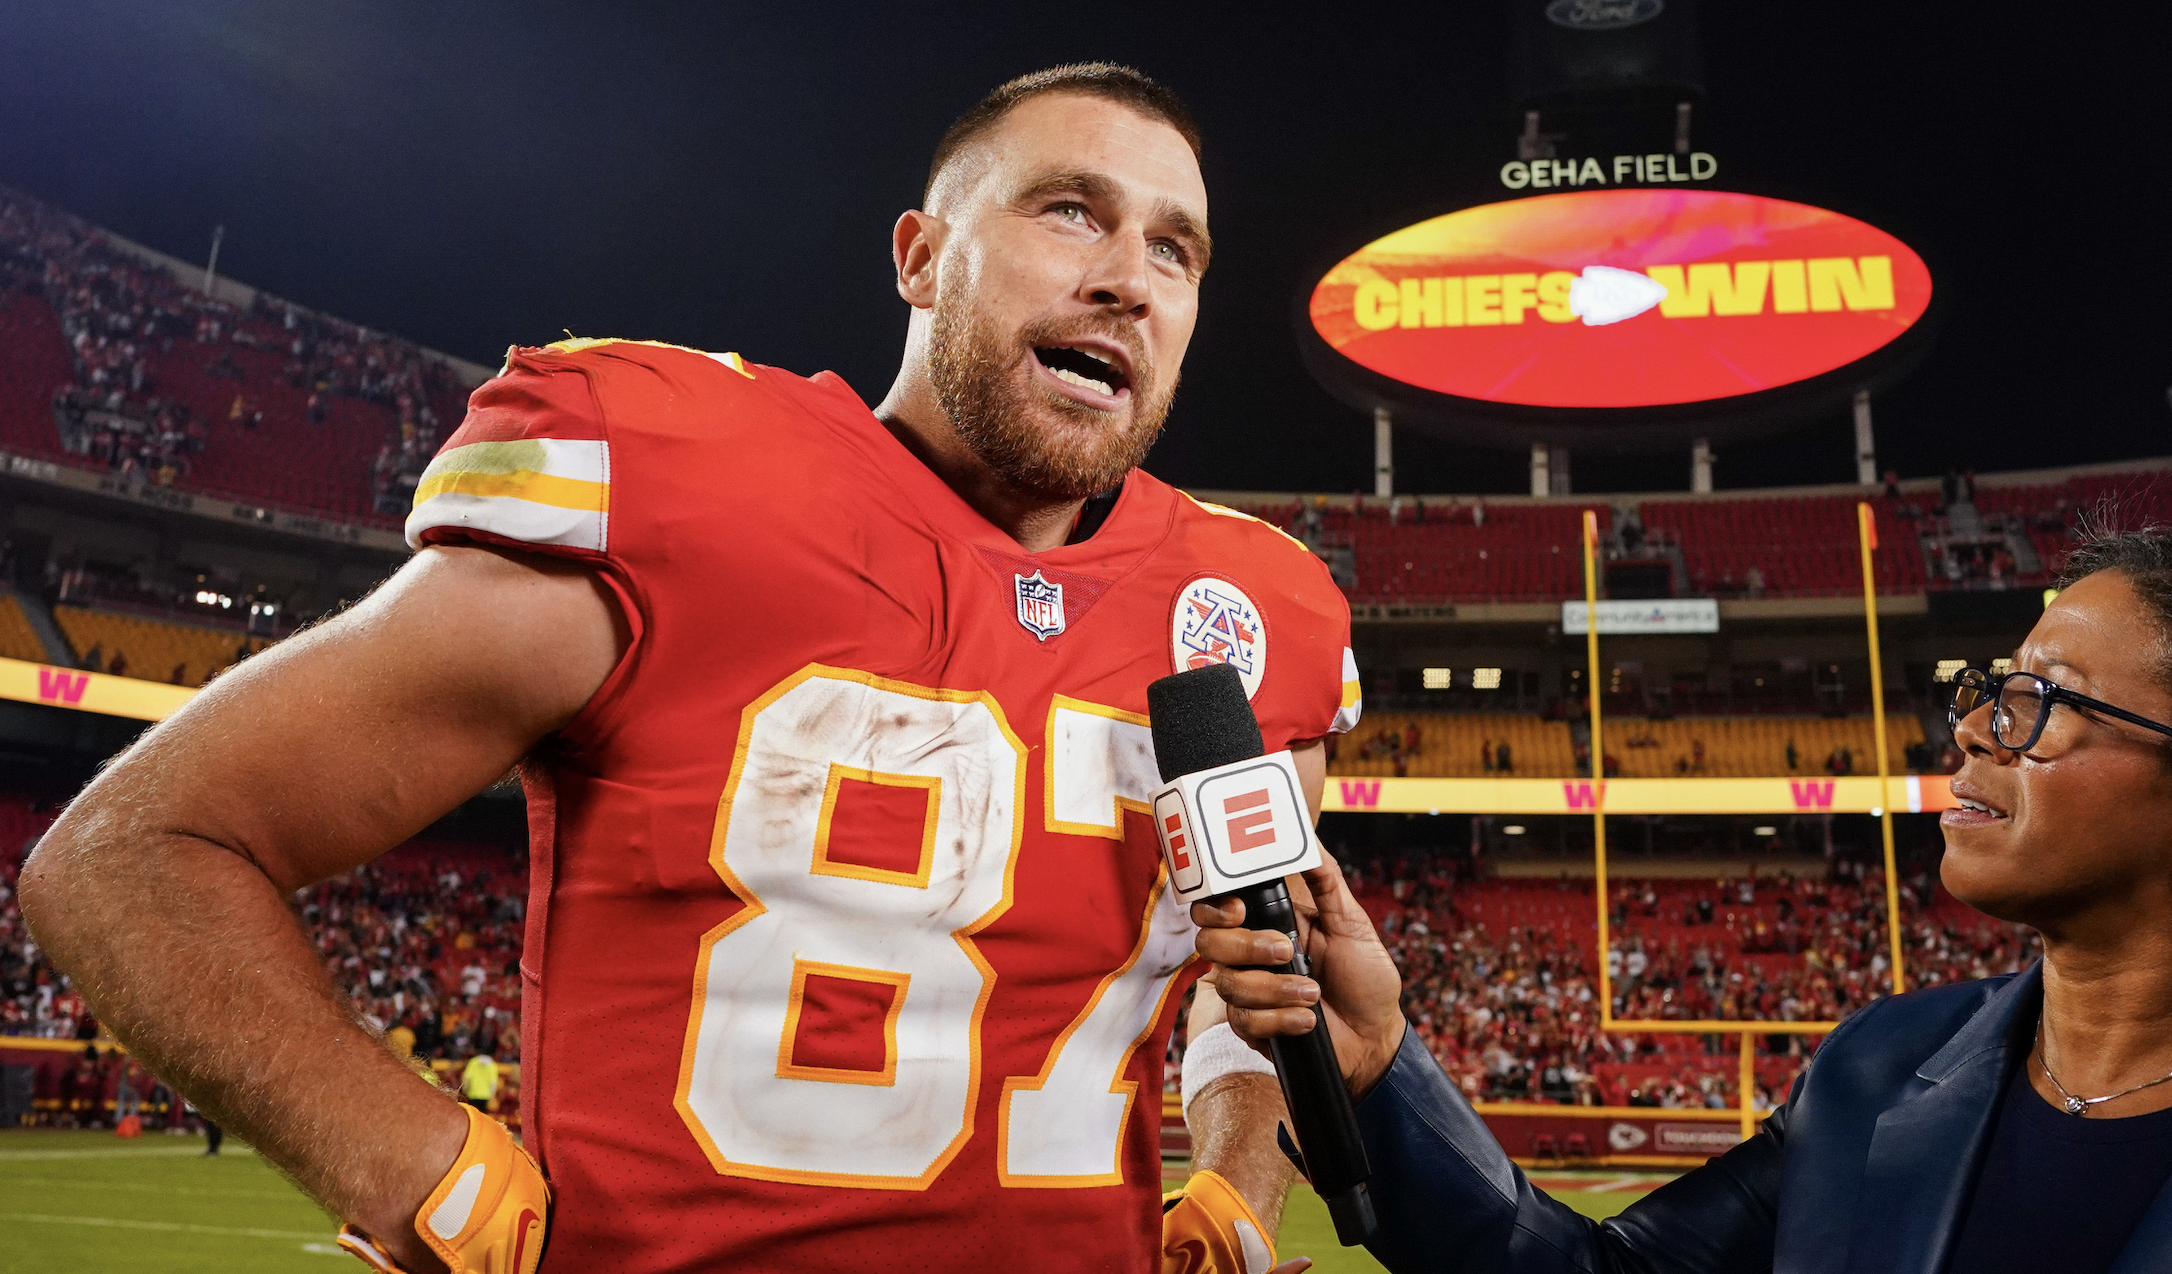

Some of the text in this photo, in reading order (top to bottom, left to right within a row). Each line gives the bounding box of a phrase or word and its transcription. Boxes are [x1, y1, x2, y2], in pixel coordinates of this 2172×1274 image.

[1500, 152, 1718, 190] GEHA FIELD
[1353, 255, 1895, 332] CHIEFS WIN
[1024, 598, 1058, 628] NFL
[38, 667, 91, 706] W
[1339, 780, 1381, 809] W
[1563, 780, 1606, 809] W
[1789, 779, 1835, 809] W
[673, 662, 1200, 1190] 87
